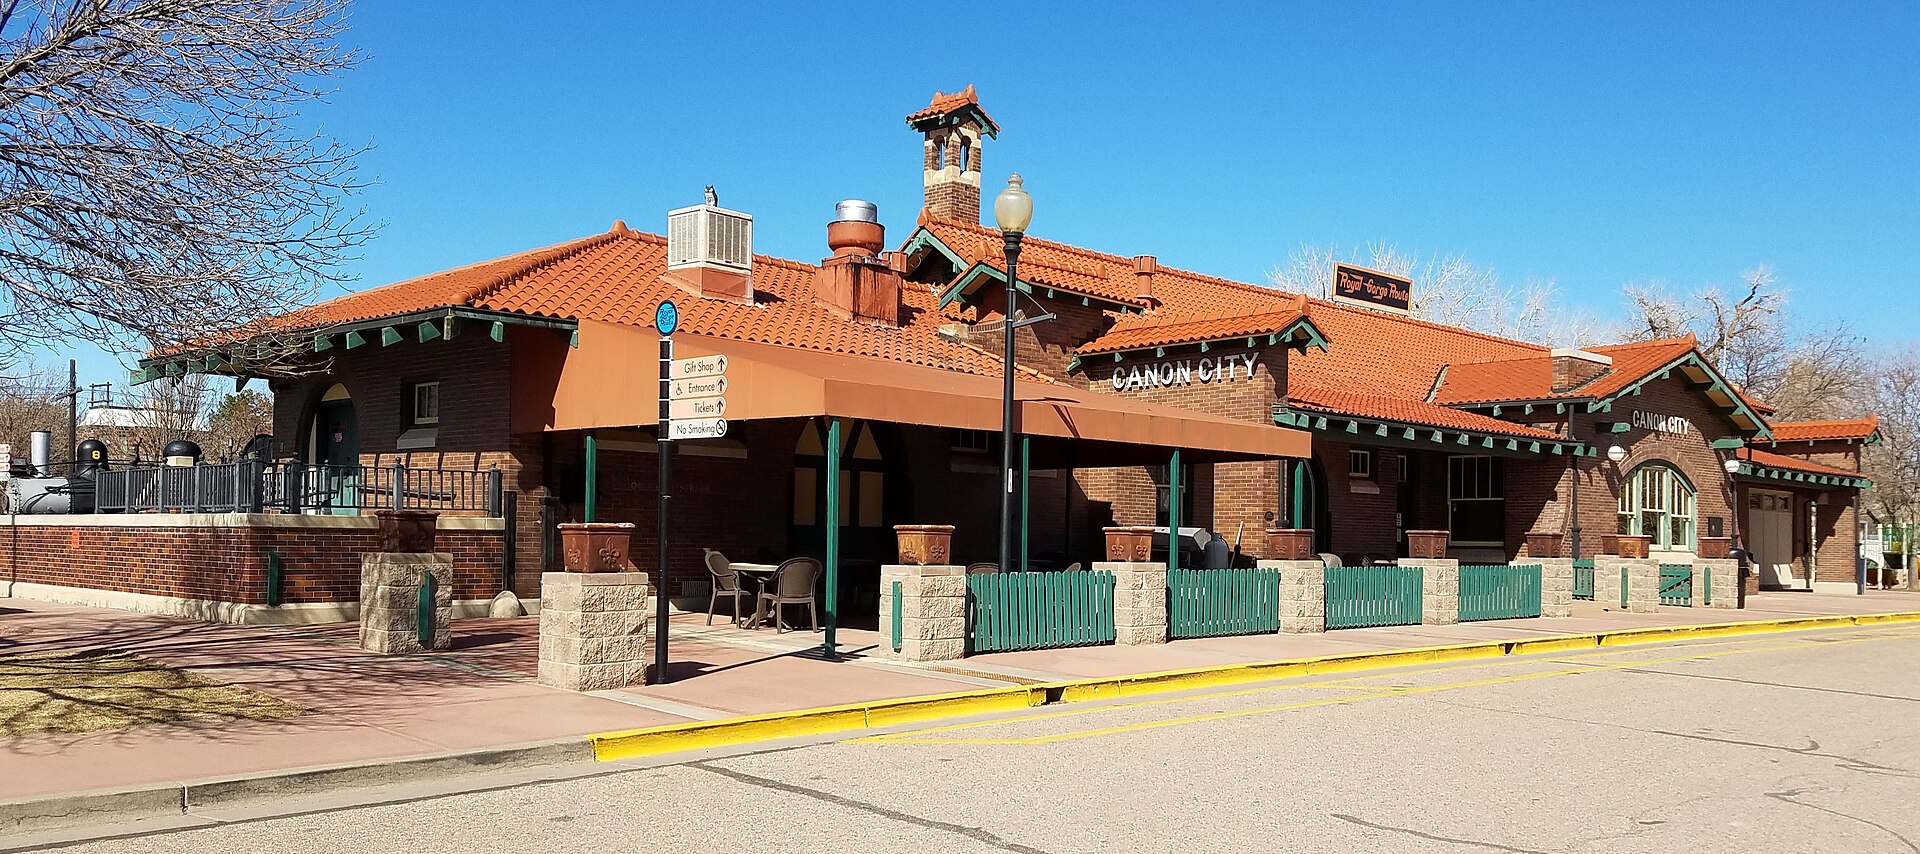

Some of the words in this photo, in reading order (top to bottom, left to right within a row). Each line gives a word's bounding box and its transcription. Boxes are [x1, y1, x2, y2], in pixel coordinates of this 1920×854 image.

[1338, 271, 1363, 293] Royal
[1363, 279, 1388, 300] Gorge
[1387, 283, 1408, 301] Route
[684, 361, 696, 373] Gift
[697, 360, 714, 373] Shop
[1112, 360, 1191, 389] CANON
[1199, 352, 1260, 382] CITY
[688, 383, 715, 393] Entrance
[694, 401, 714, 413] Tickets
[1633, 410, 1666, 432] CANON
[1667, 416, 1690, 434] CITY
[676, 425, 686, 435] No
[688, 422, 715, 436] Smoking
[92, 450, 100, 460] 8
